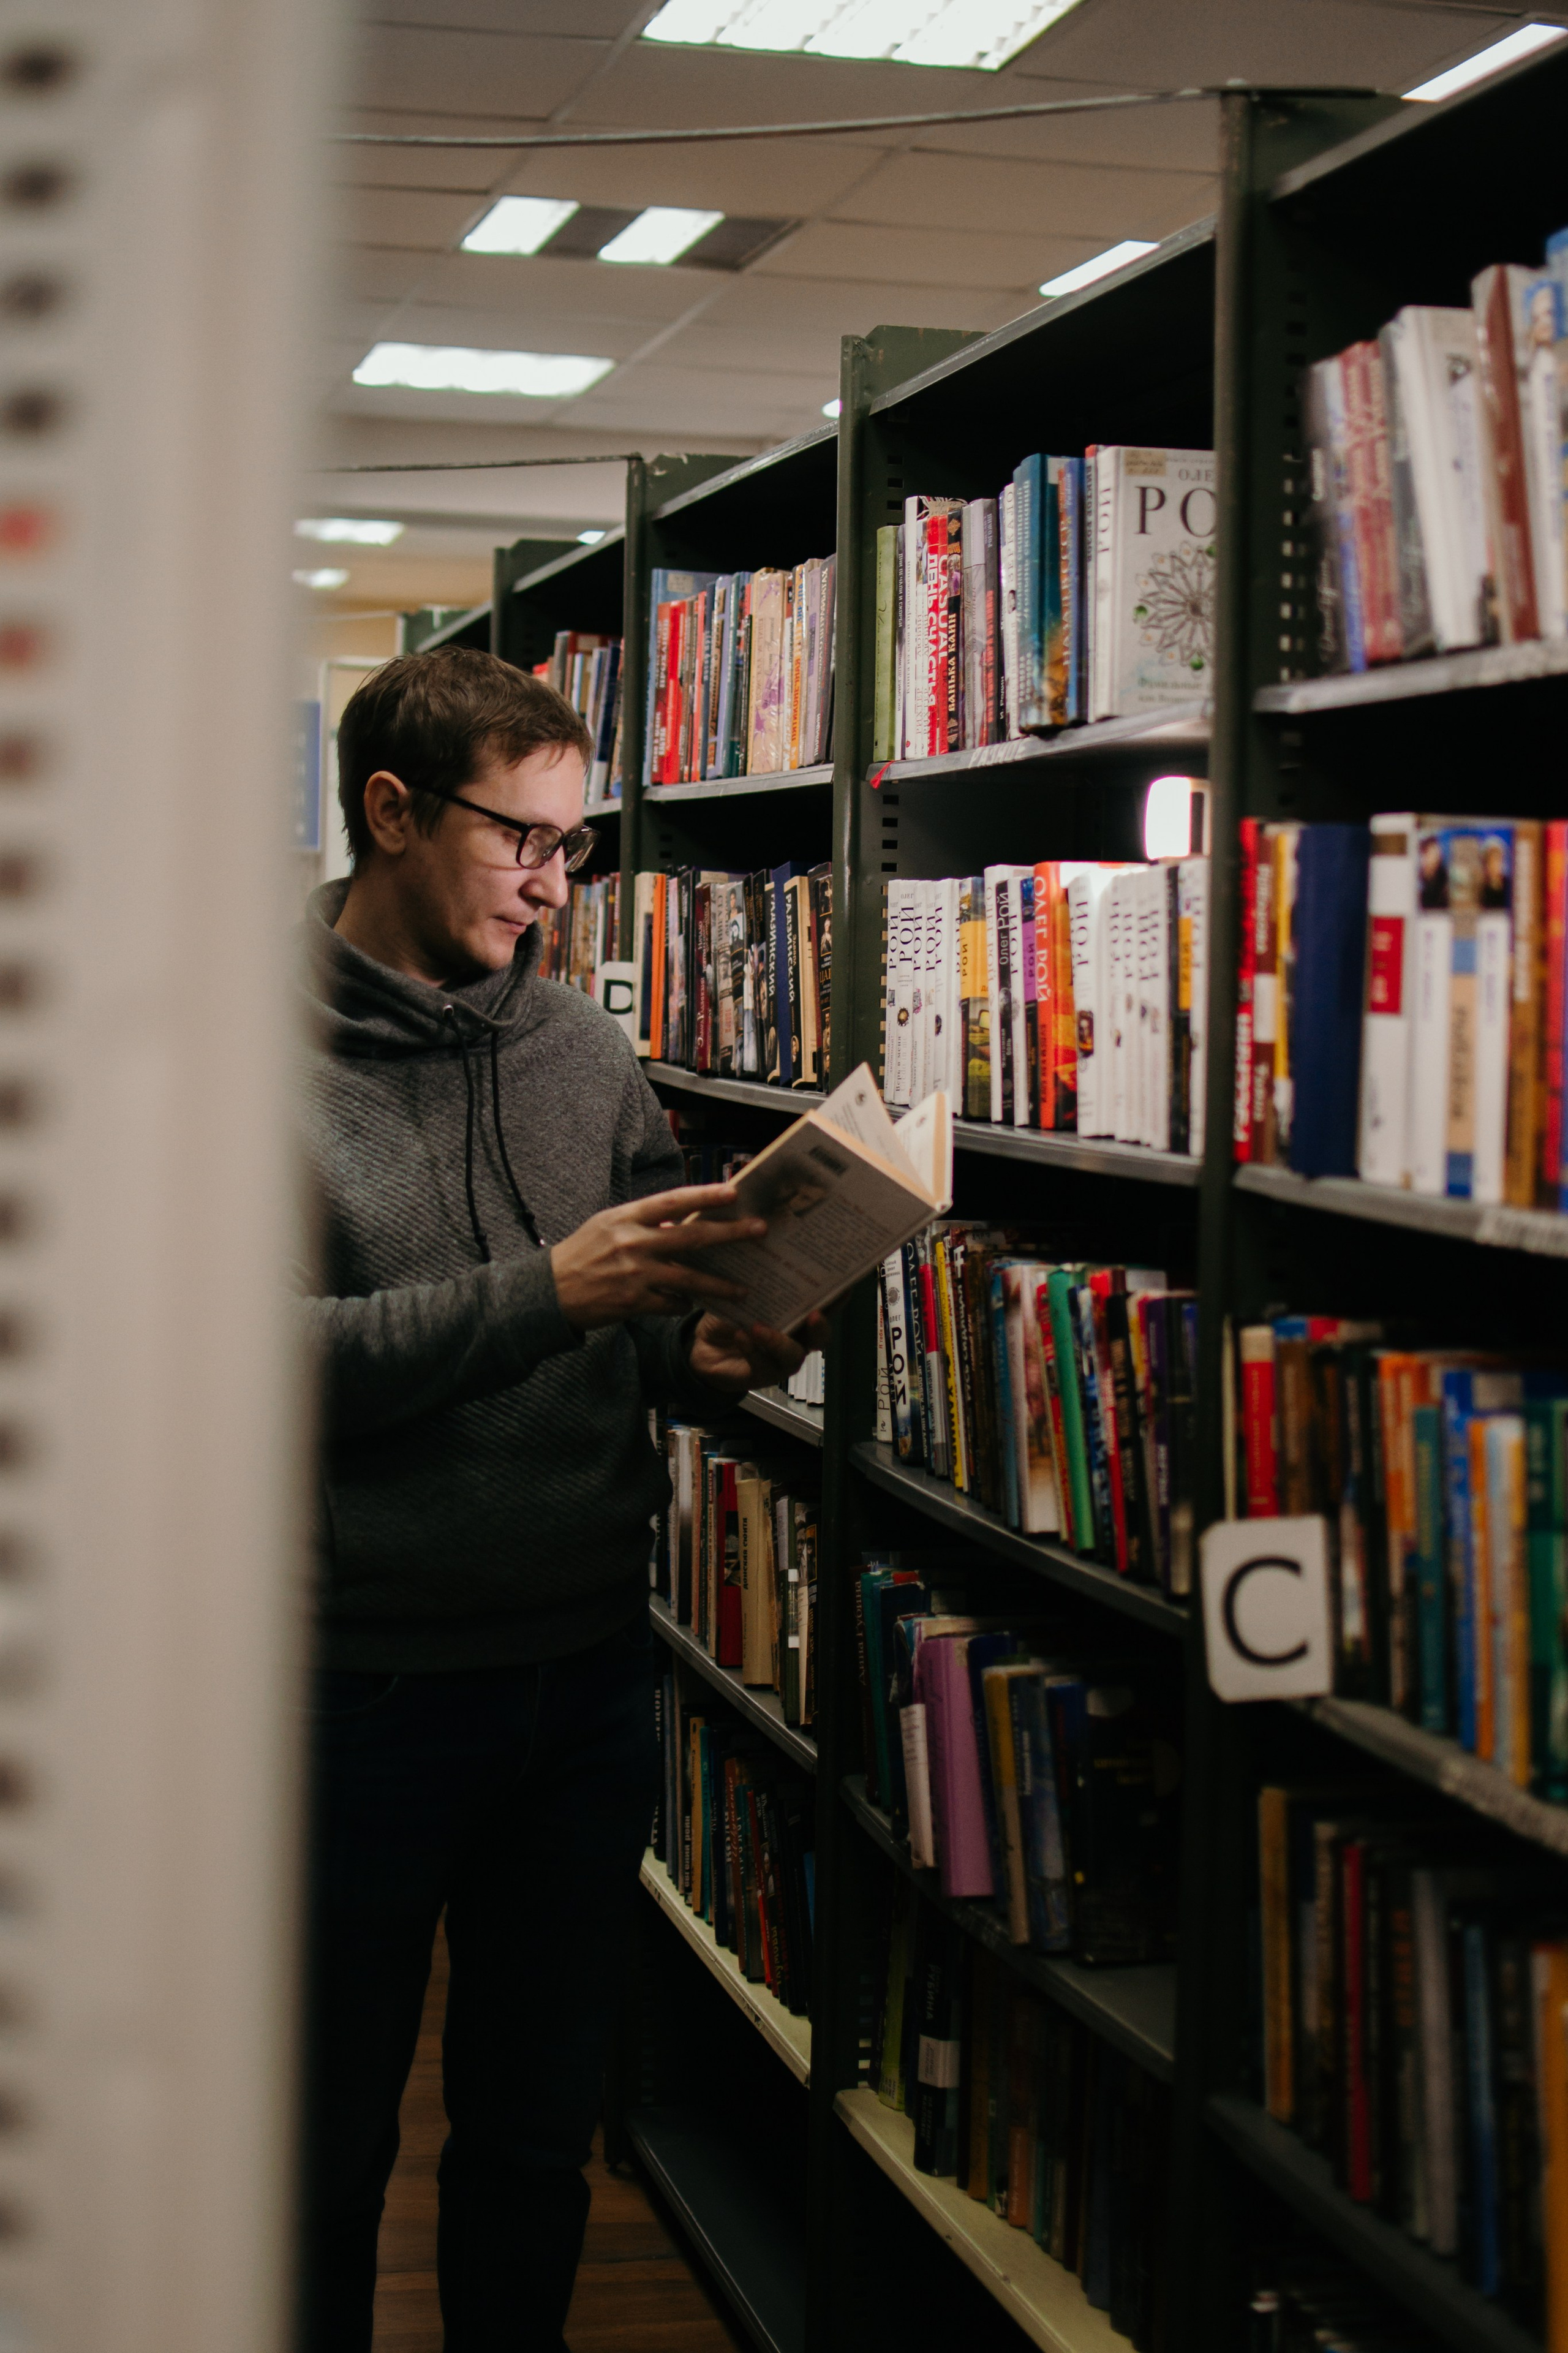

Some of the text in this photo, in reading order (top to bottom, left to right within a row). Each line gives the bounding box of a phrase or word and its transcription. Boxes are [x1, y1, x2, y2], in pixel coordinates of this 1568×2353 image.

[1178, 469, 1214, 482] ОЛЕ
[1006, 489, 1016, 583] ЗЕРКАЛО
[1133, 486, 1218, 538] РО
[927, 553, 938, 610] ДЕНЬ
[938, 554, 948, 665] CASUAL
[1061, 592, 1071, 667] НАЗАД
[927, 612, 938, 706] СЧАСТЬЯ
[948, 613, 956, 712] ВАНЬКА КАИН
[791, 658, 801, 741] ПЯТИКОНЕЧНАЯ
[786, 893, 795, 1003] РАДЗИНСКИЙ
[888, 913, 898, 970] РОЙ
[899, 906, 914, 962] РОЙ
[913, 915, 922, 971] РОЙ
[925, 915, 935, 972] РОЙ
[999, 933, 1009, 965] Олег
[1035, 876, 1051, 1002] ОЛЕГ РОЙ
[986, 943, 995, 983] РОЙ
[603, 979, 633, 1015] D
[907, 1242, 918, 1298] ОЛЕГ
[913, 1307, 924, 1355] РОЙ
[878, 1367, 890, 1410] РОЙ
[853, 1580, 867, 1686] Дина Рубина
[1221, 1555, 1309, 1667] C
[925, 1964, 937, 2020] РУБИНА
